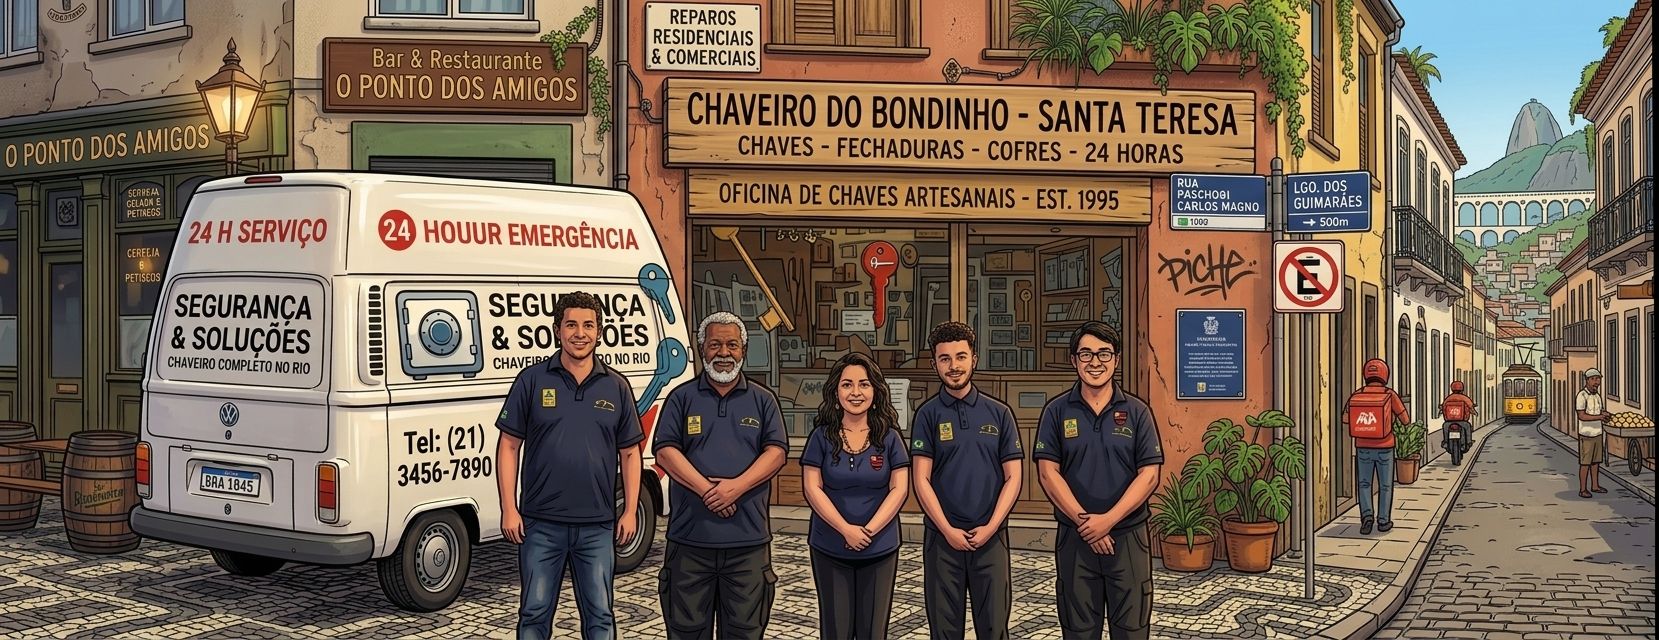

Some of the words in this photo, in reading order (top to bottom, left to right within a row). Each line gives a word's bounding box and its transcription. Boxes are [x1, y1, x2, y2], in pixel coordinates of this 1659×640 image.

[670, 8, 736, 26] REPAROS
[653, 28, 754, 46] RESIDENCIAIS
[372, 48, 404, 68] Bar
[410, 48, 423, 69] &
[430, 49, 543, 70] Restaurante
[652, 48, 662, 64] &
[666, 48, 756, 66] COMERCIAIS
[336, 74, 351, 99] O
[359, 74, 434, 100] PONTO
[441, 75, 485, 100] DOS
[492, 76, 578, 102] AMIGOS
[687, 92, 816, 128] CHAVEIRO
[826, 94, 862, 128] DO
[872, 96, 1009, 132] BONDINHO
[1038, 98, 1126, 134] SANTA
[1136, 102, 1238, 136] TERESA
[5, 144, 18, 168] O
[23, 137, 84, 166] PONTO
[90, 132, 128, 160] DOS
[133, 124, 210, 156] AMIGOS
[738, 135, 814, 157] CHAVES
[837, 137, 964, 160] FECHADURAS
[988, 140, 1062, 162] COFRES
[1085, 142, 1110, 163] 24
[1117, 143, 1184, 164] HORAS
[1177, 178, 1199, 188] RUA
[1294, 181, 1320, 194] LGO.
[1324, 180, 1348, 192] DOS
[719, 182, 792, 205] OFICINA
[800, 184, 822, 206] DE
[828, 184, 898, 207] CHAVES
[904, 186, 1016, 208] ARTESANAIS
[1036, 188, 1072, 210] EST.
[1078, 190, 1120, 211] 1995
[1177, 201, 1218, 211] CARLOS
[1221, 202, 1260, 212] MAGNO
[188, 220, 213, 244] 24
[218, 220, 233, 244] H
[238, 218, 328, 249] SERVIÇO
[383, 218, 411, 242] 24
[424, 220, 502, 245] HOUUR
[508, 221, 640, 250] EMERGÊNCIA
[1320, 217, 1349, 226] 500m
[174, 294, 312, 327] SEGURANÇA
[488, 292, 646, 322] SEGUNÇA
[171, 325, 186, 350] &
[192, 322, 312, 358] SOLUÇÕES
[492, 326, 510, 350] &
[168, 356, 216, 370] CHAVEIRO
[218, 358, 272, 374] COMPLETO
[275, 362, 290, 374] NO
[292, 362, 310, 375] RIO
[614, 352, 630, 365] NO
[632, 352, 650, 364] RIO
[404, 428, 440, 454] Tel:
[448, 424, 485, 456] (21)
[205, 474, 224, 490] BRA
[228, 478, 254, 492] 1845
[398, 456, 492, 487] 3456-7890
